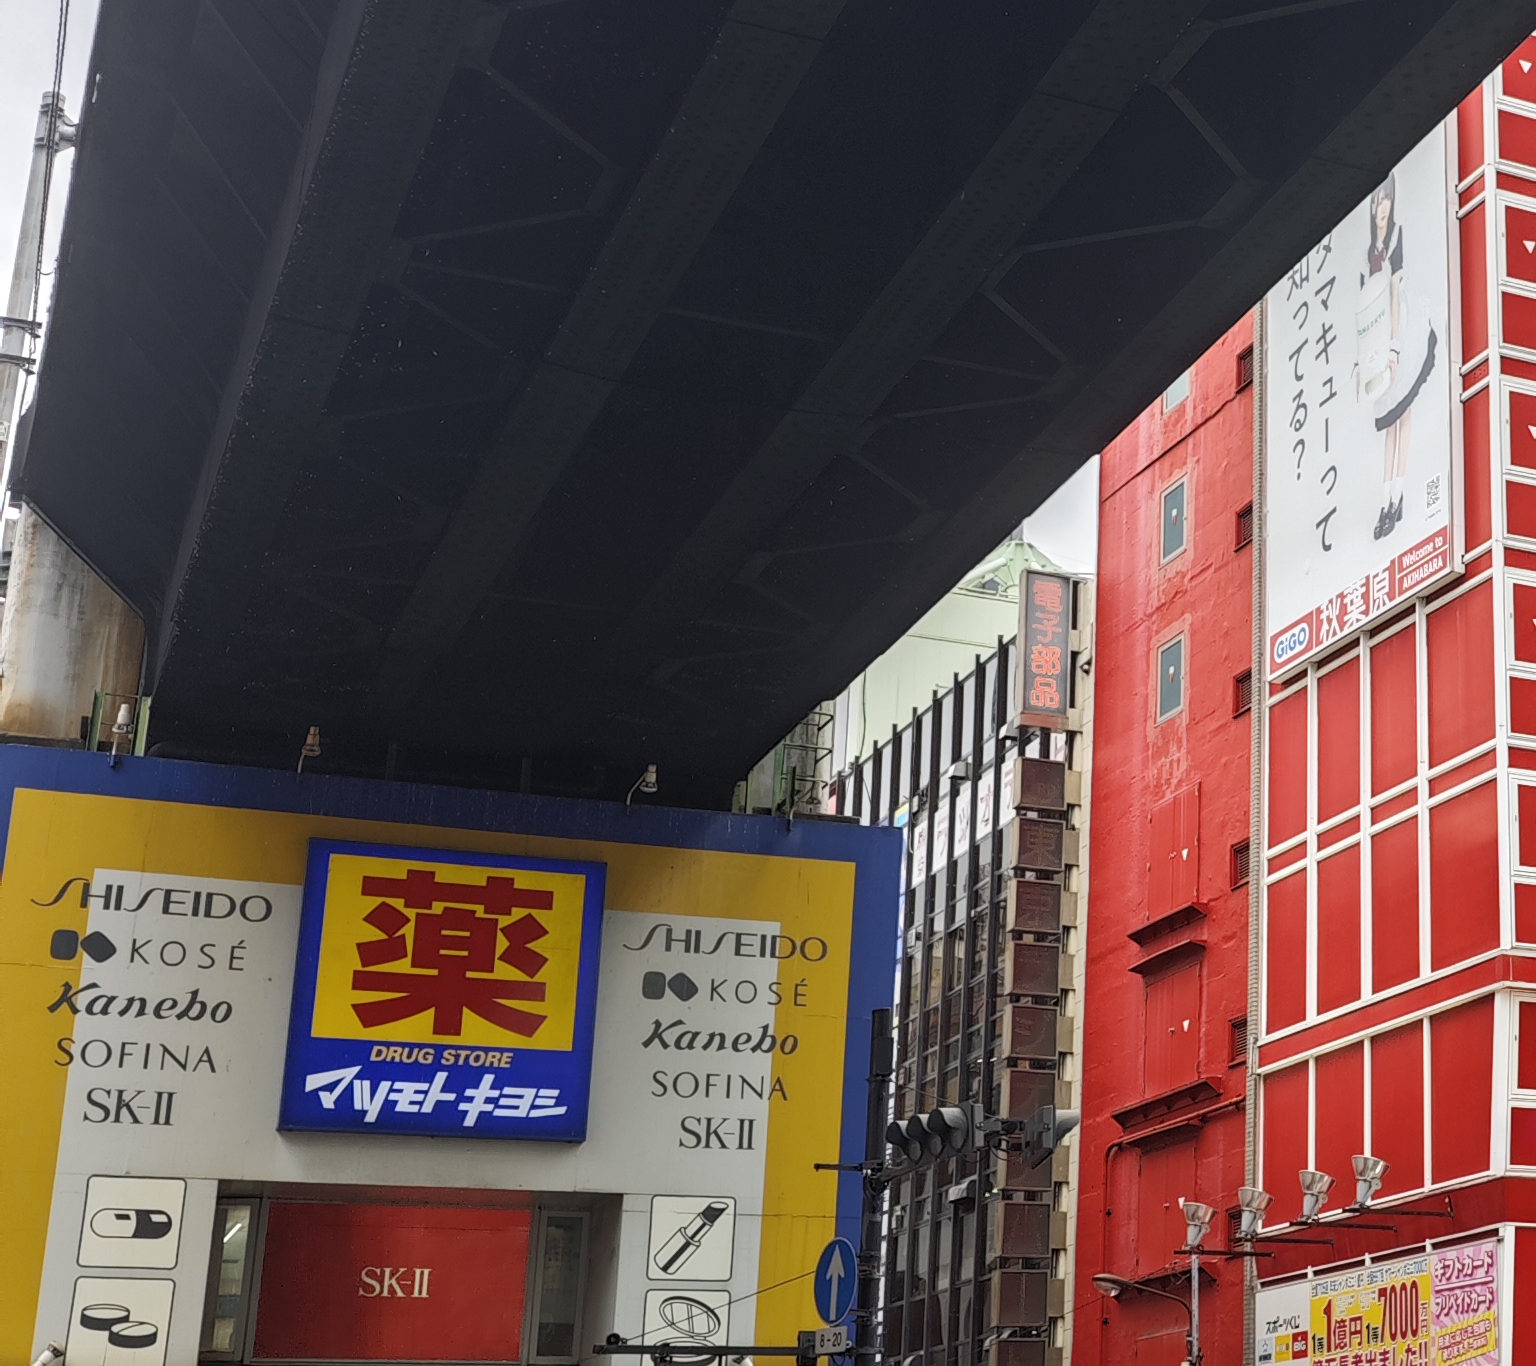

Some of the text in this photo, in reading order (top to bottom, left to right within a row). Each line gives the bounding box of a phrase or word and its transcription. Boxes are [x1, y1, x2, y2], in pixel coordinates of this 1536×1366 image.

[1402, 536, 1443, 569] Welcome to
[1402, 555, 1443, 590] AKIHABARA
[1320, 570, 1391, 643] 秋葉原
[1030, 580, 1063, 709] 電子部品
[1276, 627, 1307, 659] GiGO
[30, 877, 273, 923] SHISEIDO
[130, 938, 247, 971] KOSÉ
[350, 868, 555, 1039] 薬
[622, 923, 828, 962] SHISEIDO
[47, 981, 233, 1023] Kanebo
[709, 978, 809, 1007] KOSÉ
[641, 1019, 799, 1055] Kanebo
[54, 1037, 216, 1073] SOFINA
[369, 1045, 513, 1068] DRUG STORE
[305, 1065, 568, 1127] マツモトキヨシ
[651, 1071, 788, 1101] SOFINA
[83, 1087, 178, 1126] SK-II
[679, 1116, 757, 1150] SK-II
[357, 1267, 431, 1300] SK-II
[1434, 1251, 1494, 1283] ギフトカード
[1434, 1287, 1494, 1320] プリペイドカード
[819, 1331, 843, 1349] 8-20
[1266, 1315, 1301, 1334] スポーツくじ
[1293, 1341, 1307, 1353] BIG
